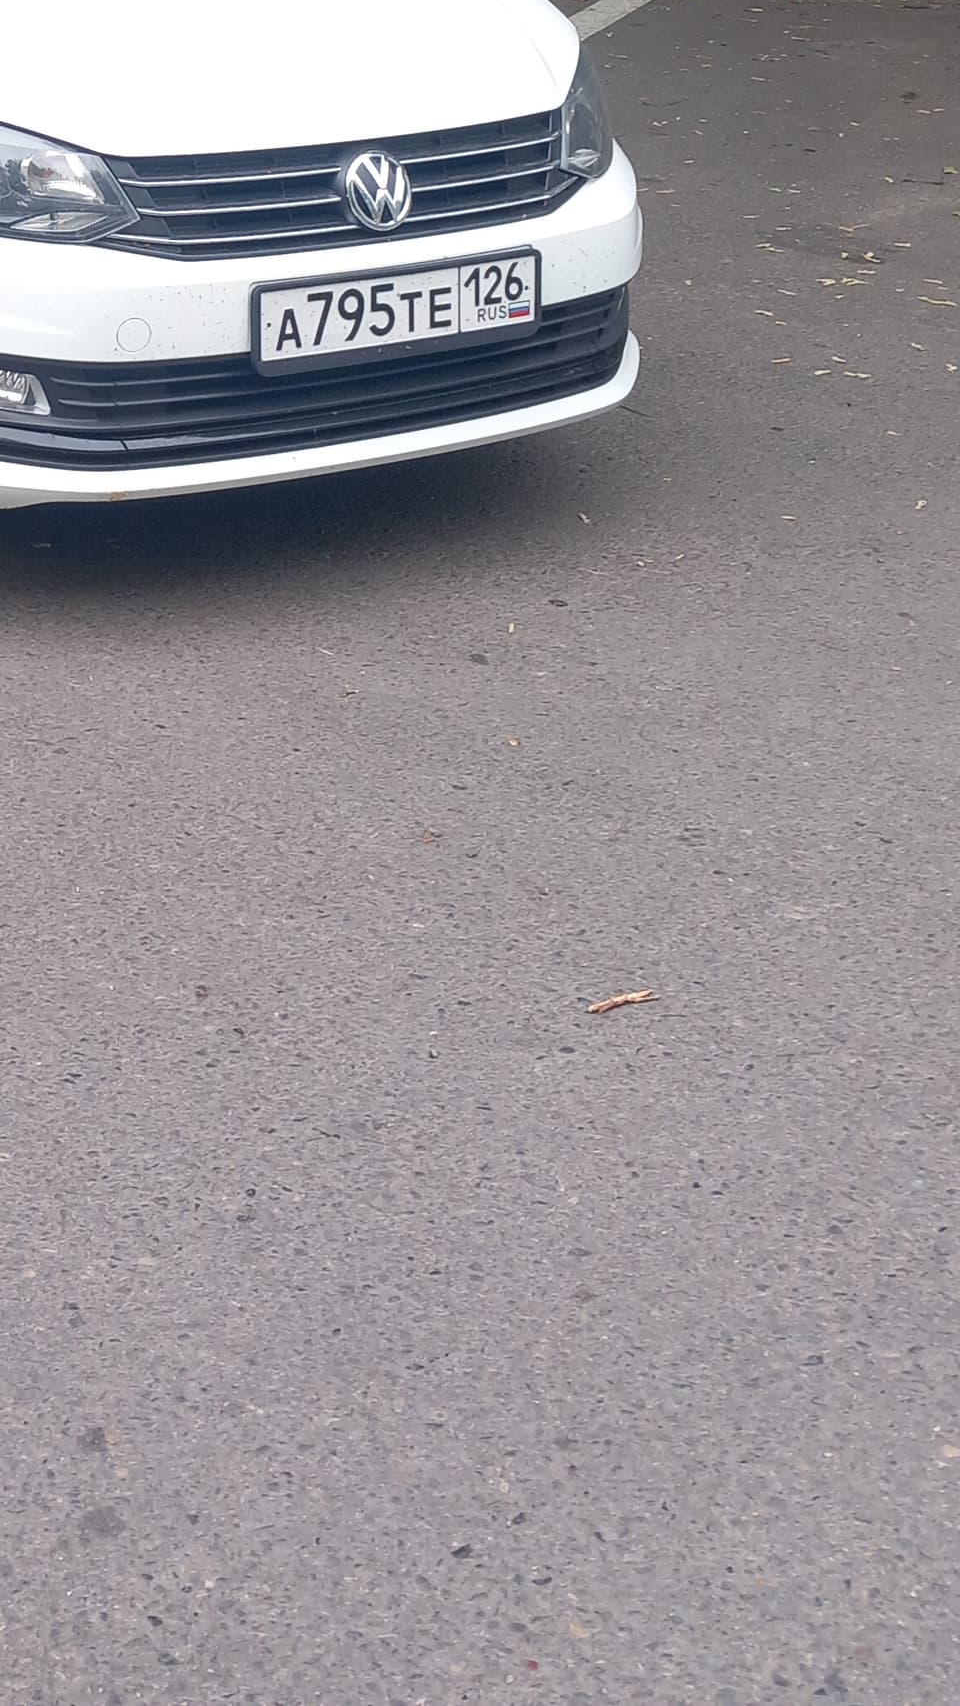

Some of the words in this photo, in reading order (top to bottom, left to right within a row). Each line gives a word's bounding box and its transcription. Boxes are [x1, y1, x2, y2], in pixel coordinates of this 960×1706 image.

[276, 283, 452, 351] А795ТЕ
[464, 261, 524, 306] 126
[477, 305, 508, 322] RUS
